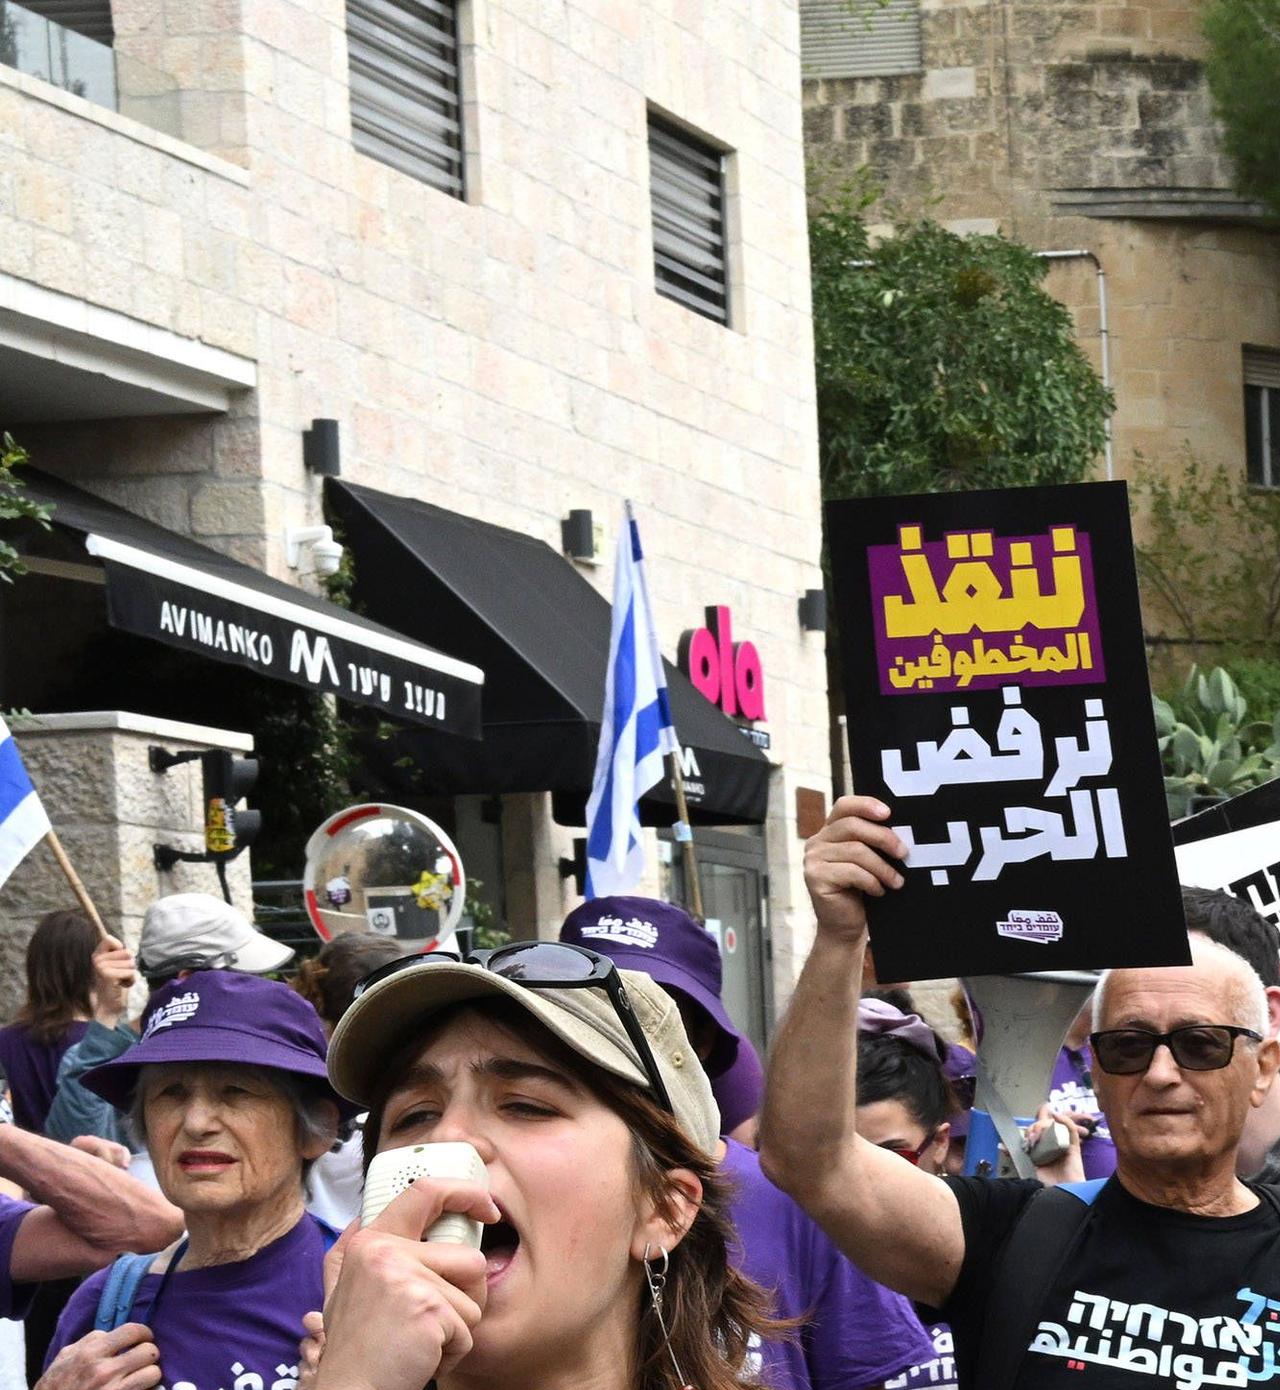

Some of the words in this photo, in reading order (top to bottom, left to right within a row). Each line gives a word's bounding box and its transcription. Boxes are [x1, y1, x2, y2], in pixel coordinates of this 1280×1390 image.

[884, 526, 1085, 638] ننقذ
[161, 601, 272, 665] AVIMANKO
[889, 632, 1092, 688] المخطوفين
[881, 686, 1113, 797] نرفض
[891, 788, 1128, 886] الحرب
[1067, 1290, 1262, 1356] אזרחיה
